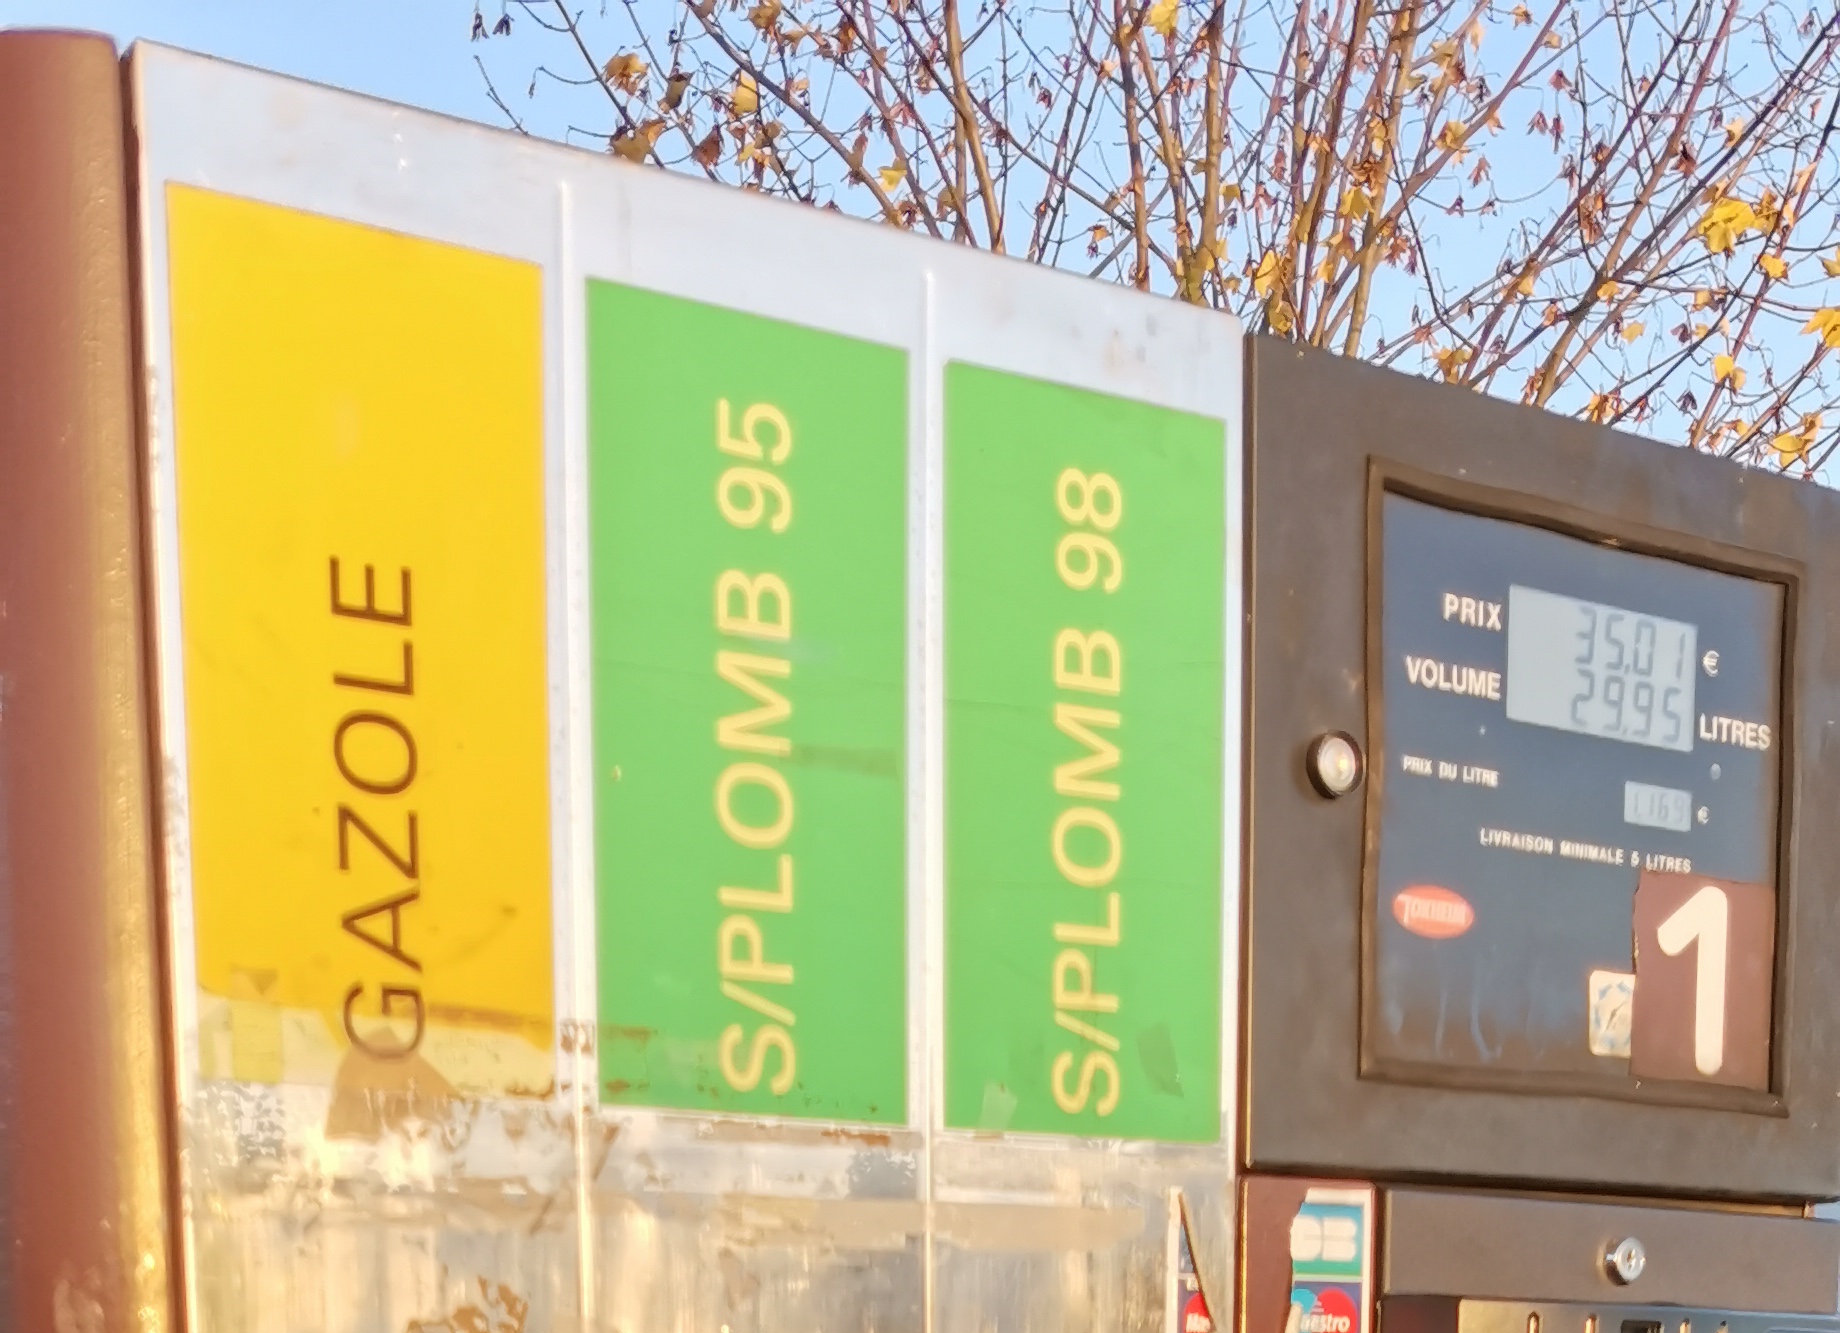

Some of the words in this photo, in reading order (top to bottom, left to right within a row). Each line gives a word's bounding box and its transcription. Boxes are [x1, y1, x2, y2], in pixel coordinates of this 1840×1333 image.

[715, 399, 793, 532] 95
[1055, 466, 1124, 597] 98
[1443, 592, 1502, 632] PRIX
[1405, 654, 1502, 701] VOLUME
[1702, 650, 1720, 677] €
[1402, 754, 1432, 777] PRIX
[1438, 761, 1458, 781] DU
[1462, 766, 1499, 788] LITRE
[1700, 713, 1772, 751] LITRES
[329, 554, 426, 1062] GAZOLE
[715, 568, 796, 1096] S/PLOMB
[1480, 827, 1553, 855] LIVRAISON
[1559, 840, 1624, 866] MINIMALE
[1630, 851, 1640, 868] 5
[1646, 853, 1692, 874] LITRES
[1053, 627, 1122, 1117] S/PLOMB
[1657, 886, 1728, 1076] 1
